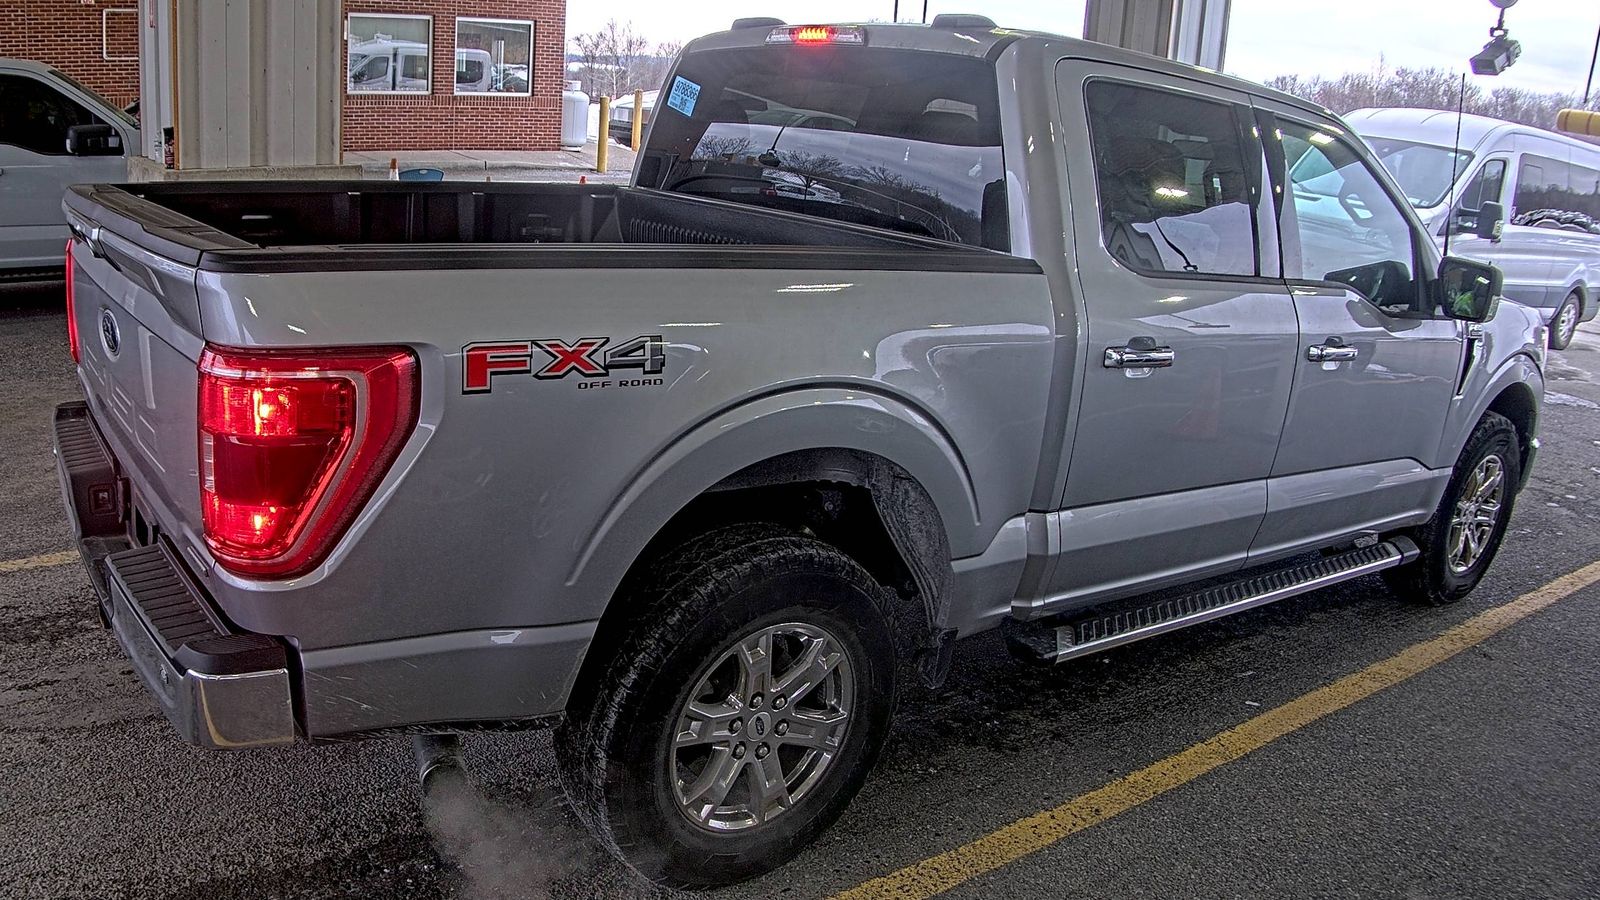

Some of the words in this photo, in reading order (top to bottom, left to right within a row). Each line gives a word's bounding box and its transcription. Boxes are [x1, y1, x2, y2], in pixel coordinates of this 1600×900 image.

[462, 335, 665, 395] FX4
[578, 381, 612, 390] OFF
[619, 378, 664, 388] ROAD
